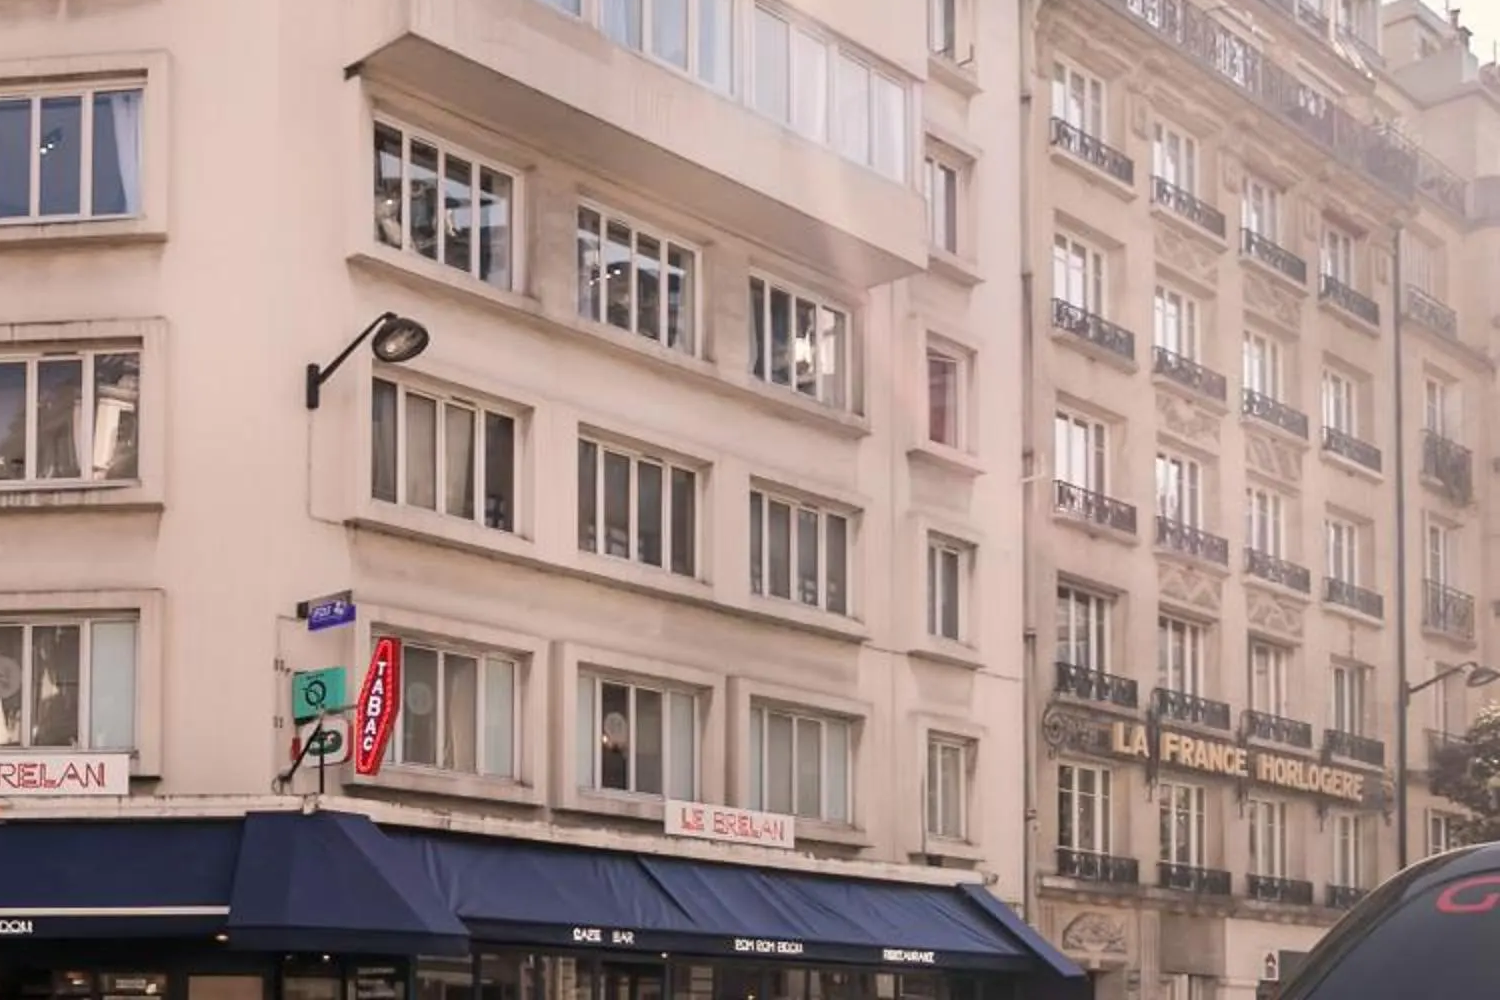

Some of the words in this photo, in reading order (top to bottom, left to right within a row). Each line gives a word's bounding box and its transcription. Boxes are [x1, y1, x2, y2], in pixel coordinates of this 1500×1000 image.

[363, 661, 387, 752] TABAC
[1112, 721, 1150, 758] LA
[1160, 732, 1249, 777] FRANCE
[1257, 754, 1364, 802] HORLOGERE
[681, 807, 705, 831] LE
[713, 811, 784, 841] BRELAN
[612, 930, 635, 945] BAR
